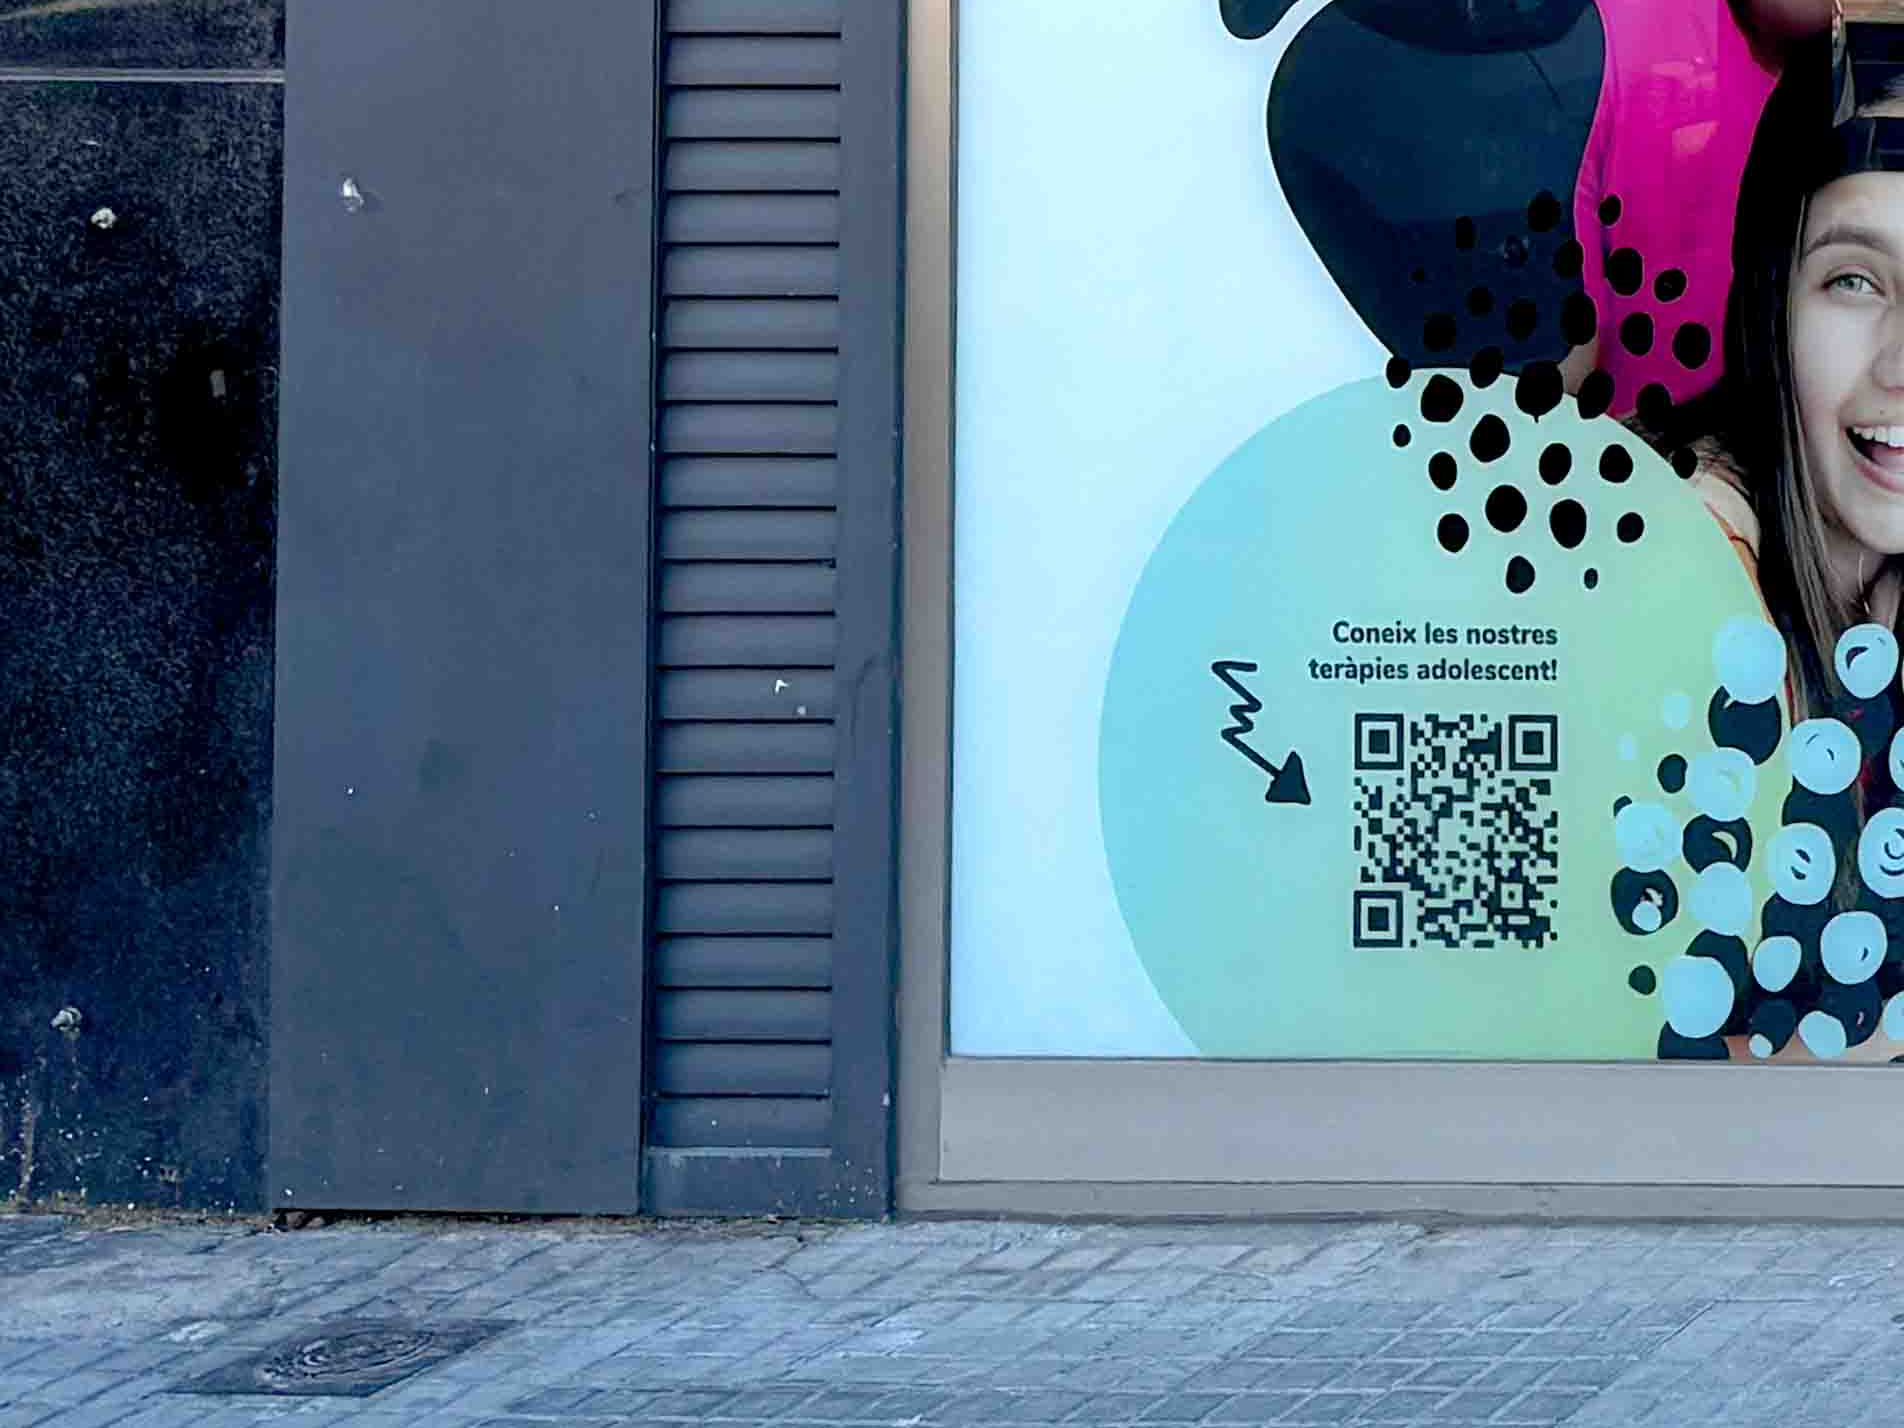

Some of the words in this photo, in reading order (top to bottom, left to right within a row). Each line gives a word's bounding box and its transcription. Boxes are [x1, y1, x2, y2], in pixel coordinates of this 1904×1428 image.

[1333, 621, 1417, 645] Coneix
[1424, 621, 1458, 645] les
[1465, 623, 1559, 646] nostres
[1308, 655, 1409, 684] teràpies
[1416, 657, 1559, 682] adolescent!
